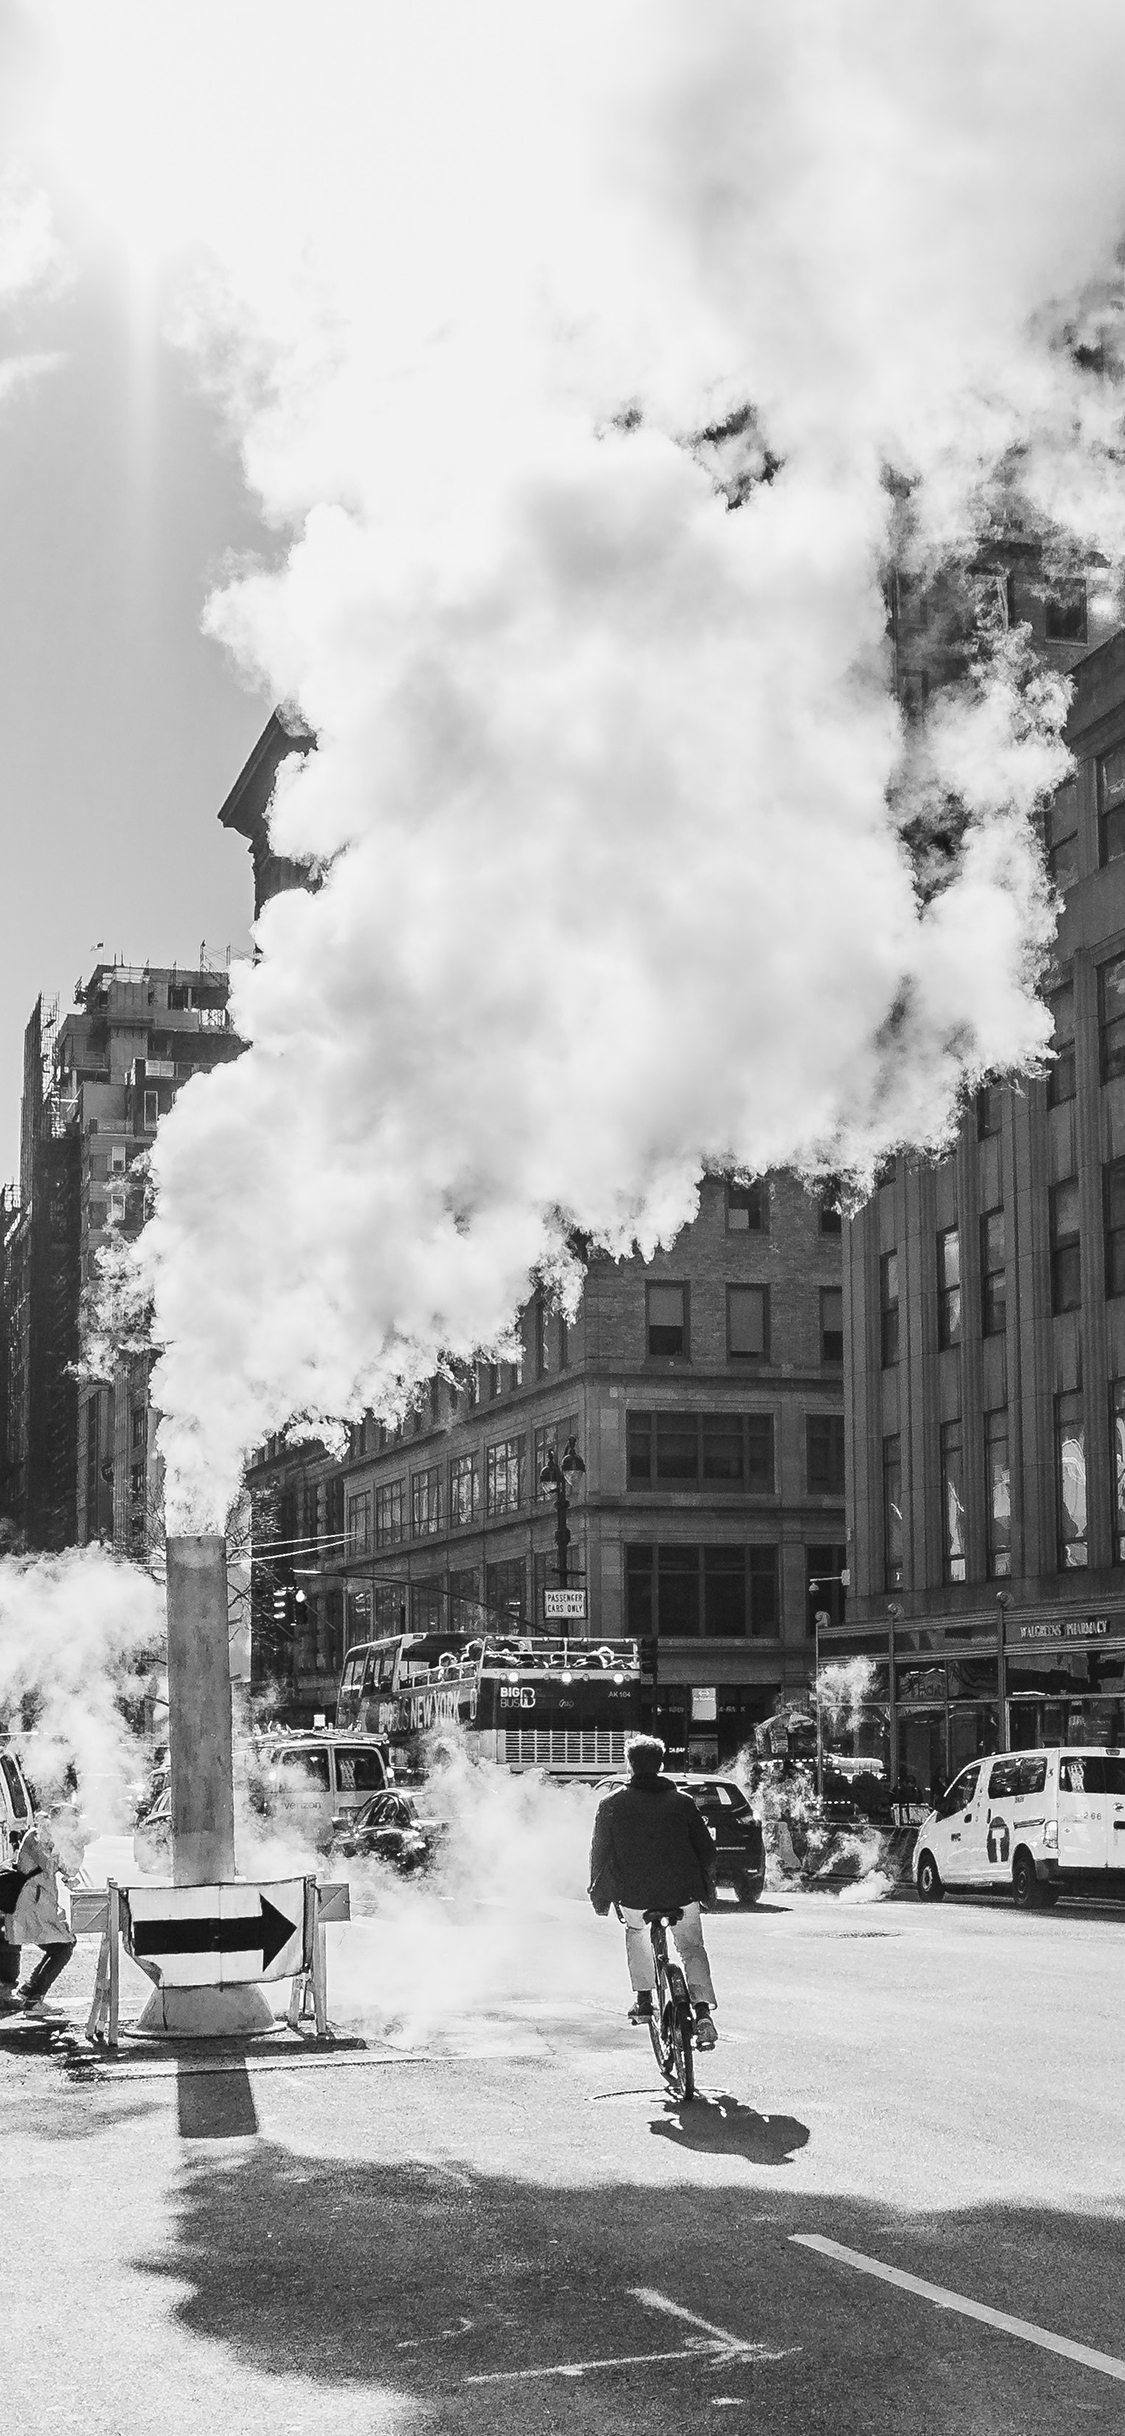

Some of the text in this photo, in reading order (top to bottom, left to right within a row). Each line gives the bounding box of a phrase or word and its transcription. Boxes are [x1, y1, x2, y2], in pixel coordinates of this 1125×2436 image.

[547, 1594, 583, 1602] PASSENGER
[547, 1604, 583, 1613] CARS ONLY
[1019, 1620, 1108, 1638] WALGREENS PHARMACY
[500, 1687, 520, 1698] BIG
[500, 1698, 520, 1708] BUS
